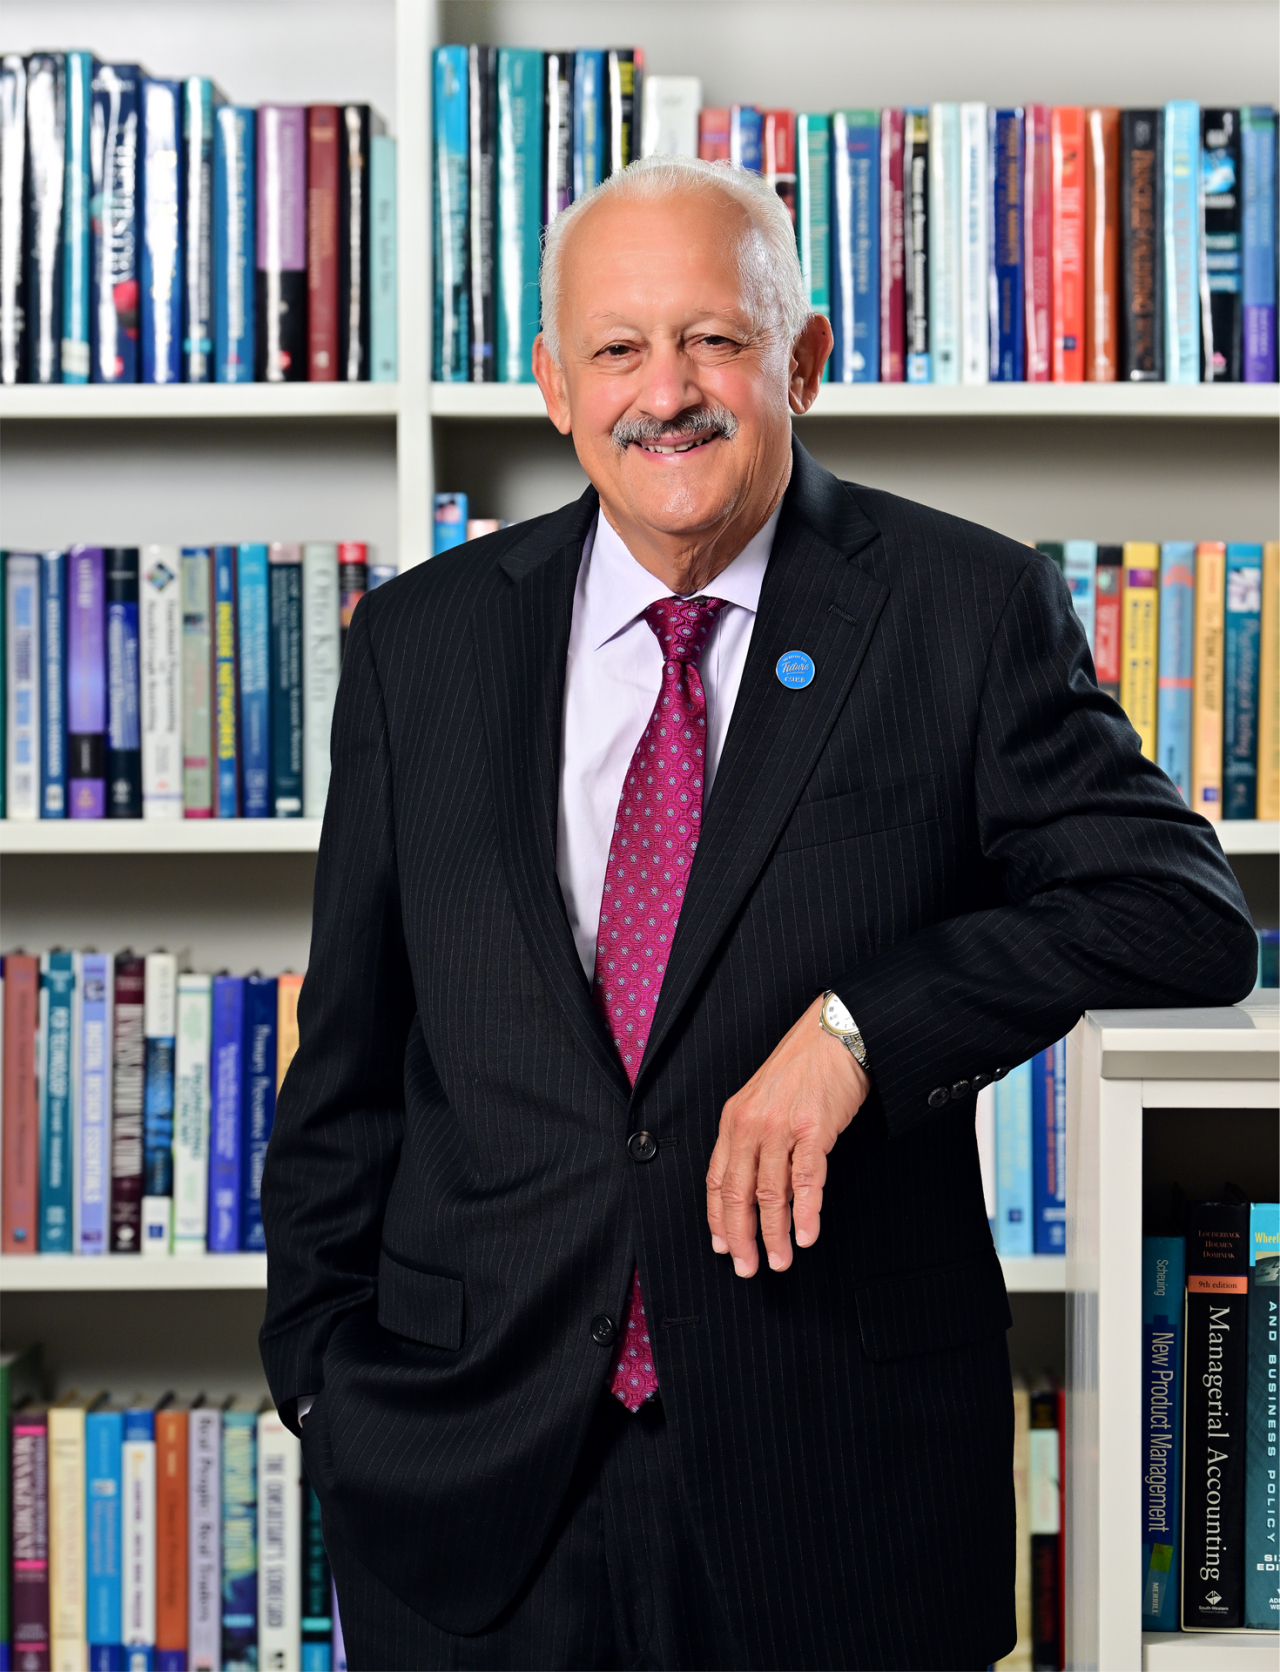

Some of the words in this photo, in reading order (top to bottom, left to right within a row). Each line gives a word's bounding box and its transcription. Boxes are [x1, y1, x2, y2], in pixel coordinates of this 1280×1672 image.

[218, 602, 233, 659] INSIDE
[781, 662, 810, 673] Future
[218, 662, 234, 760] NETWORKS
[84, 1020, 104, 1071] DIGITAL
[84, 1074, 104, 1122] DESIGN
[83, 1126, 104, 1204] ESSENTIALS
[1154, 1259, 1169, 1296] Scheuing
[1198, 1281, 1211, 1289] 9th
[1212, 1281, 1238, 1289] edition
[1268, 1300, 1277, 1342] AND
[1151, 1332, 1175, 1367] New
[1202, 1304, 1231, 1439] Managerial
[1150, 1369, 1174, 1430] Product
[1267, 1354, 1276, 1457] BUSINESS
[198, 1417, 213, 1450] Real
[267, 1454, 286, 1475] THE
[1144, 1433, 1173, 1532] Management
[13, 1436, 35, 1560] MANAGEMENT
[1199, 1446, 1229, 1581] Accounting
[1266, 1469, 1276, 1544] POLICY
[198, 1524, 213, 1558] Real
[1151, 1582, 1159, 1614] MERRILL
